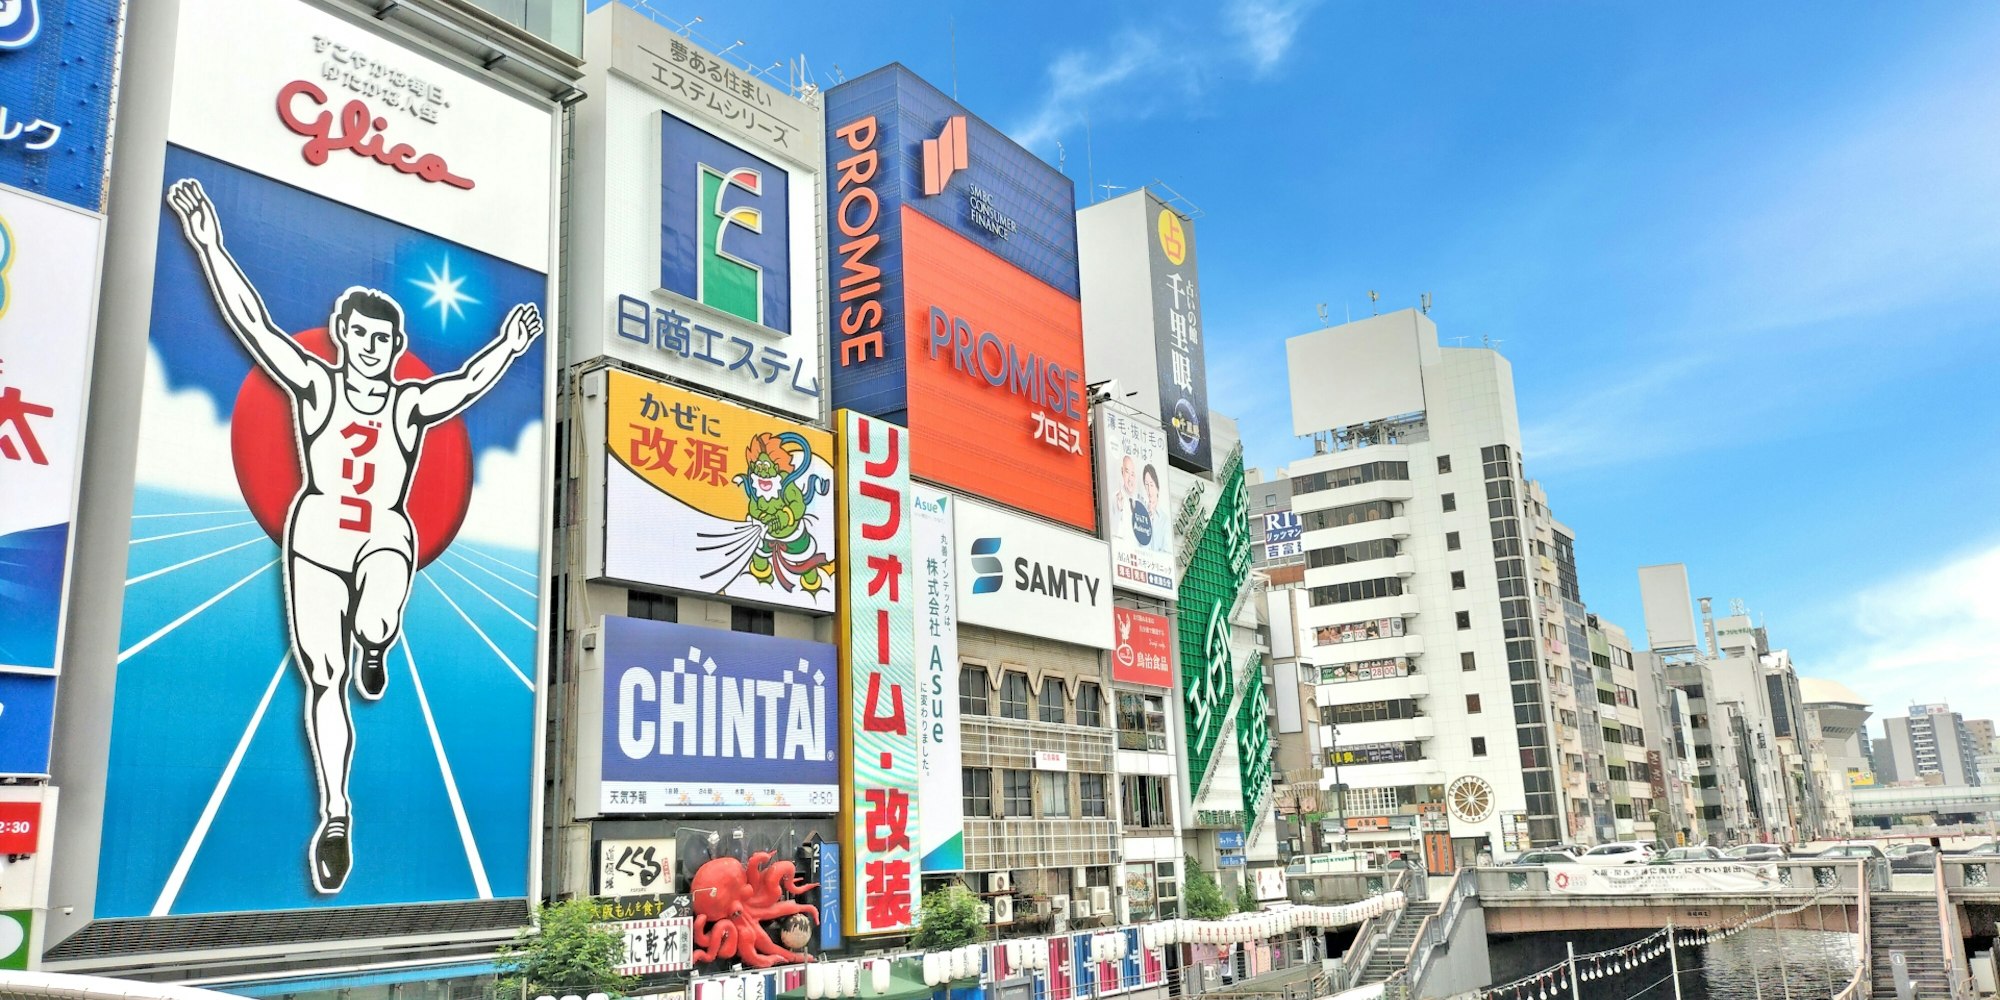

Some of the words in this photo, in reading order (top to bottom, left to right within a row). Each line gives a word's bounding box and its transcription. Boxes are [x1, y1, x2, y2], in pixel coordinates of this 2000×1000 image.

[322, 61, 438, 124] ゆたかな人生
[670, 38, 772, 107] 夢ある住まい
[276, 80, 475, 190] Glico
[651, 62, 788, 149] エステムシリーズ
[969, 183, 994, 208] SMBC
[970, 196, 1018, 234] CONSUMER
[971, 209, 1009, 241] FINANCE
[836, 115, 884, 367] PROMISE
[1163, 212, 1182, 260] 占
[618, 293, 820, 397] 日商エステム
[927, 304, 1082, 421] PROMISE
[1166, 272, 1193, 395] 千里眼
[640, 392, 722, 438] かぜに
[1031, 411, 1084, 456] プロミス
[339, 420, 382, 533] グリコ
[629, 422, 729, 487] 改源
[914, 496, 938, 513] Asue
[926, 557, 942, 637] 株式会社
[1015, 556, 1100, 607] SAMTY
[618, 646, 826, 761] CHINTAI
[858, 417, 912, 929] リフォーム・改装
[929, 644, 943, 743] Asue
[1186, 598, 1231, 757] エイブル
[920, 682, 930, 776] に変わりました。
[609, 790, 647, 804] 天気予報
[615, 846, 662, 887] くくる
[813, 843, 820, 873] 2F
[679, 907, 690, 916] 2F
[620, 928, 678, 964] に乾杯
